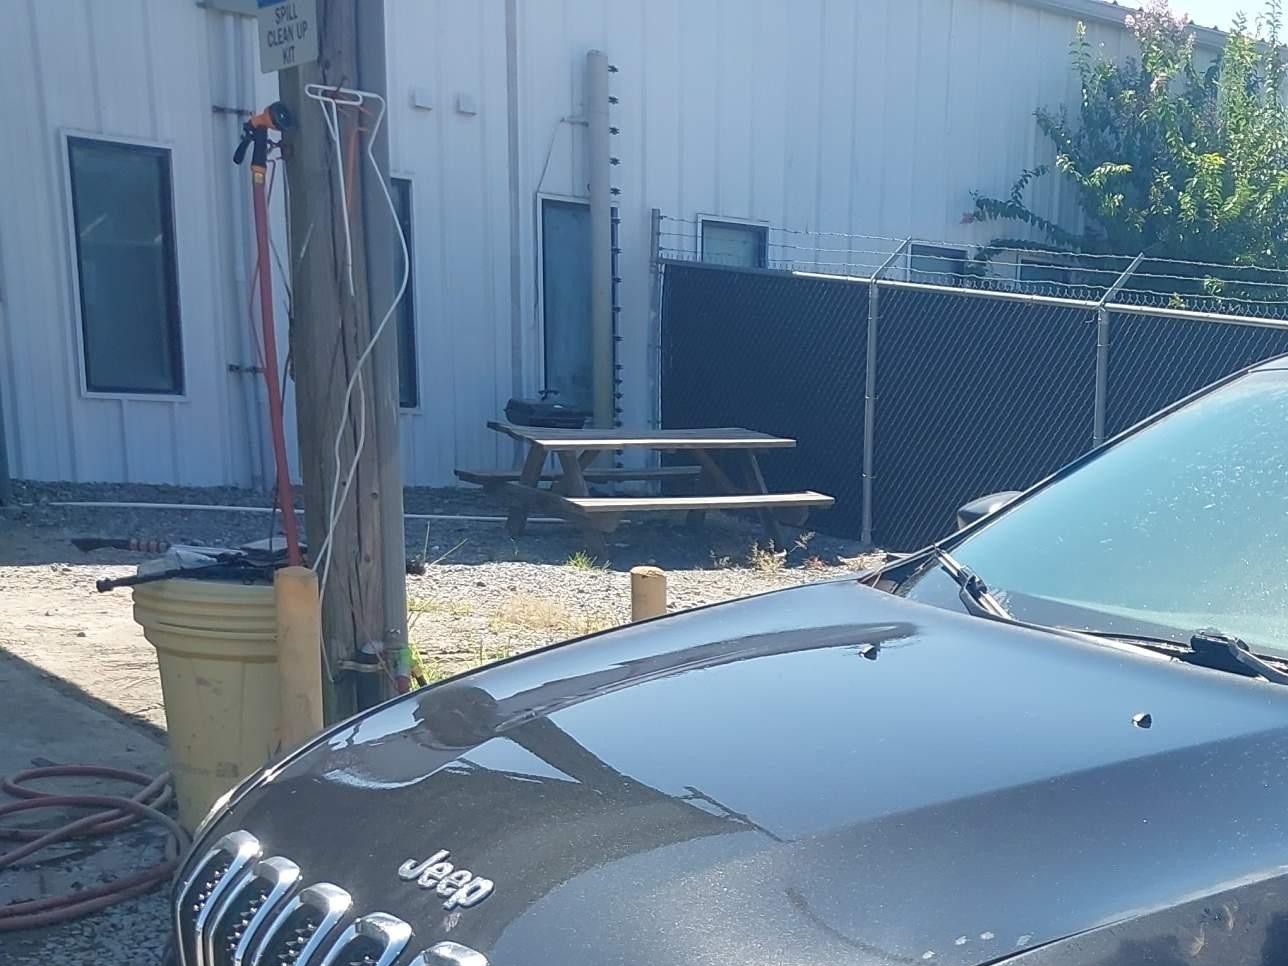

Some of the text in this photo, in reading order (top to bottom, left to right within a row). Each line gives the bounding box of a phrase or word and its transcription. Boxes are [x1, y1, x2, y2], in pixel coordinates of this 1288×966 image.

[275, 2, 298, 25] SPILL
[267, 20, 308, 48] CLEAN UP
[282, 45, 296, 65] KIT
[398, 849, 494, 909] Jeep
